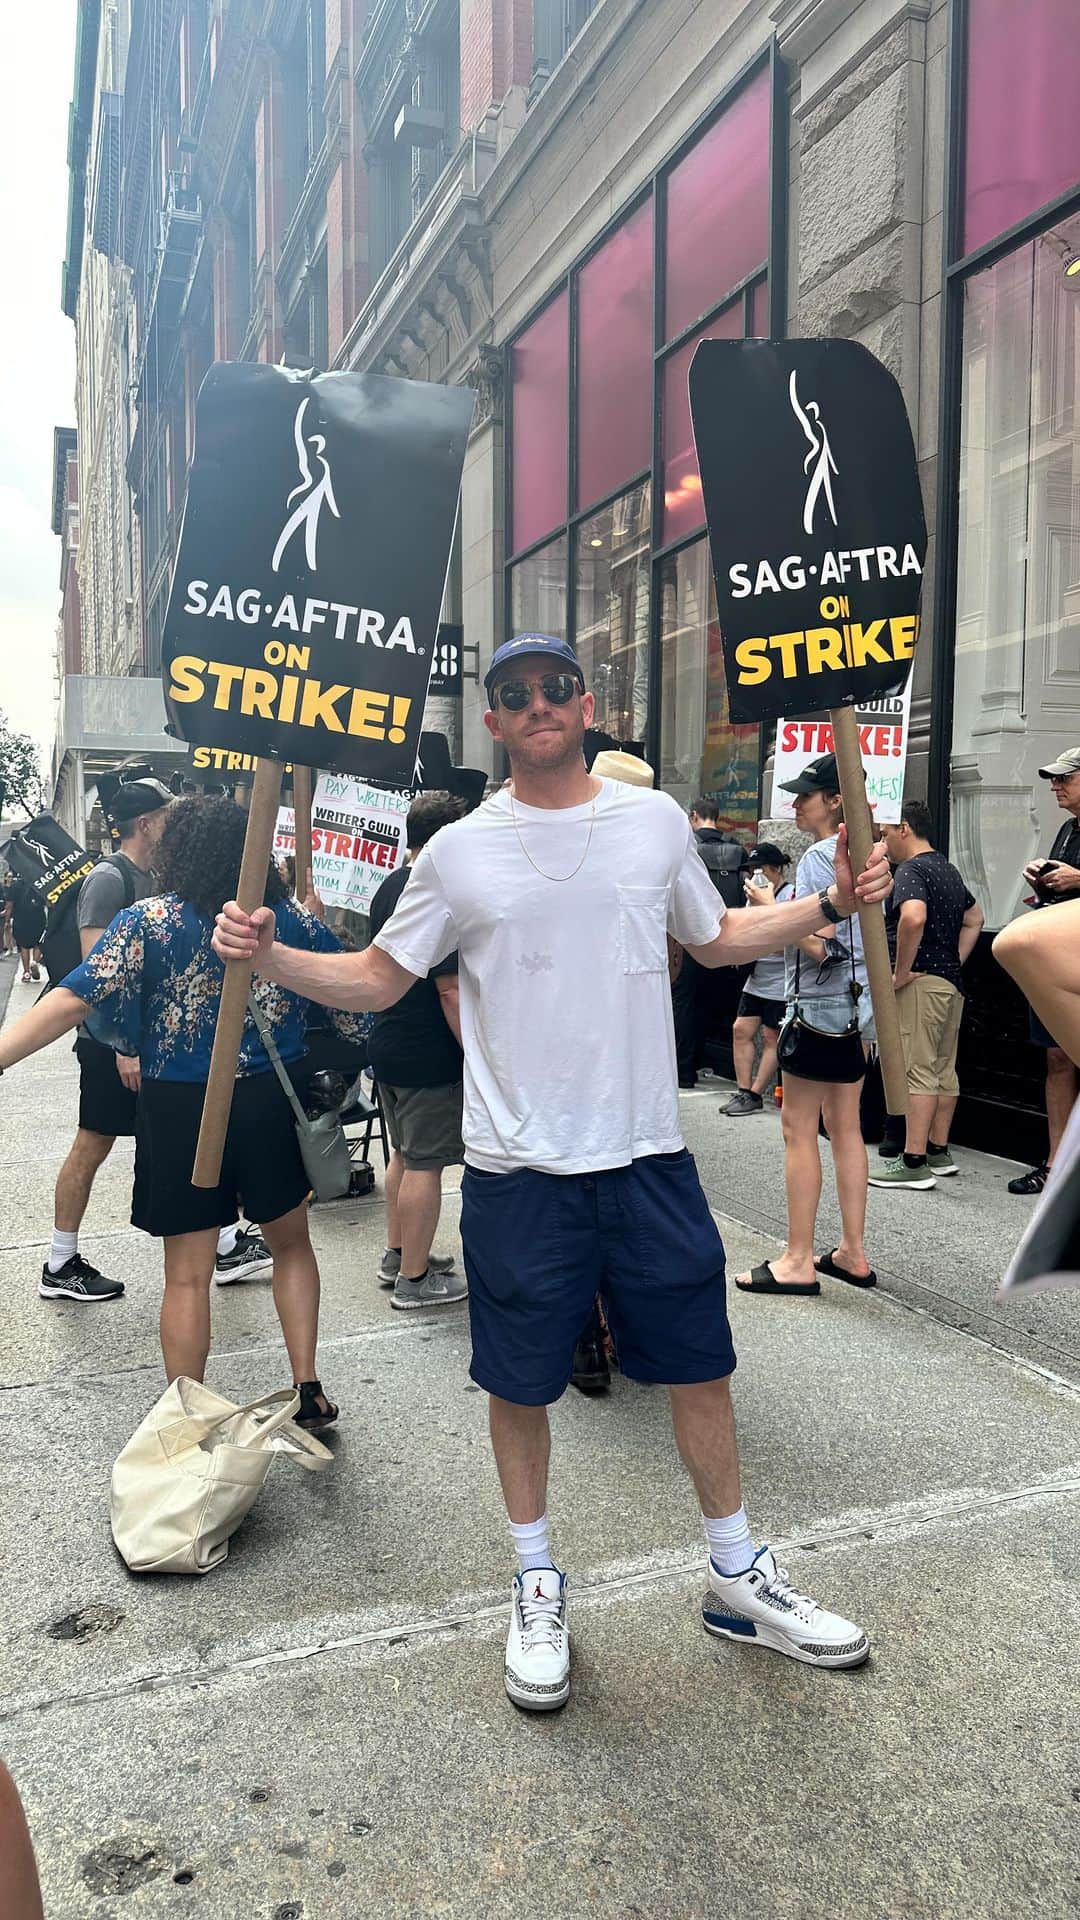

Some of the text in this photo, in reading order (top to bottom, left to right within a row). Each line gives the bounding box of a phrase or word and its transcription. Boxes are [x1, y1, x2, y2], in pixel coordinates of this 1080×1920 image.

[820, 595, 850, 620] ON
[264, 640, 311, 671] ON
[168, 655, 412, 745] STRIKE!
[857, 698, 904, 713] GUILD
[781, 723, 903, 757] STRKE!
[192, 746, 293, 773] STRI
[326, 778, 349, 797] PAY
[356, 785, 410, 814] WRITERS
[315, 806, 365, 828] WRITERS
[368, 820, 401, 838] GUILD
[351, 827, 363, 837] ON
[311, 828, 398, 870] STRIKE!
[312, 856, 387, 882] NVEST IN YOU
[312, 874, 369, 897] OTTOM LINE
